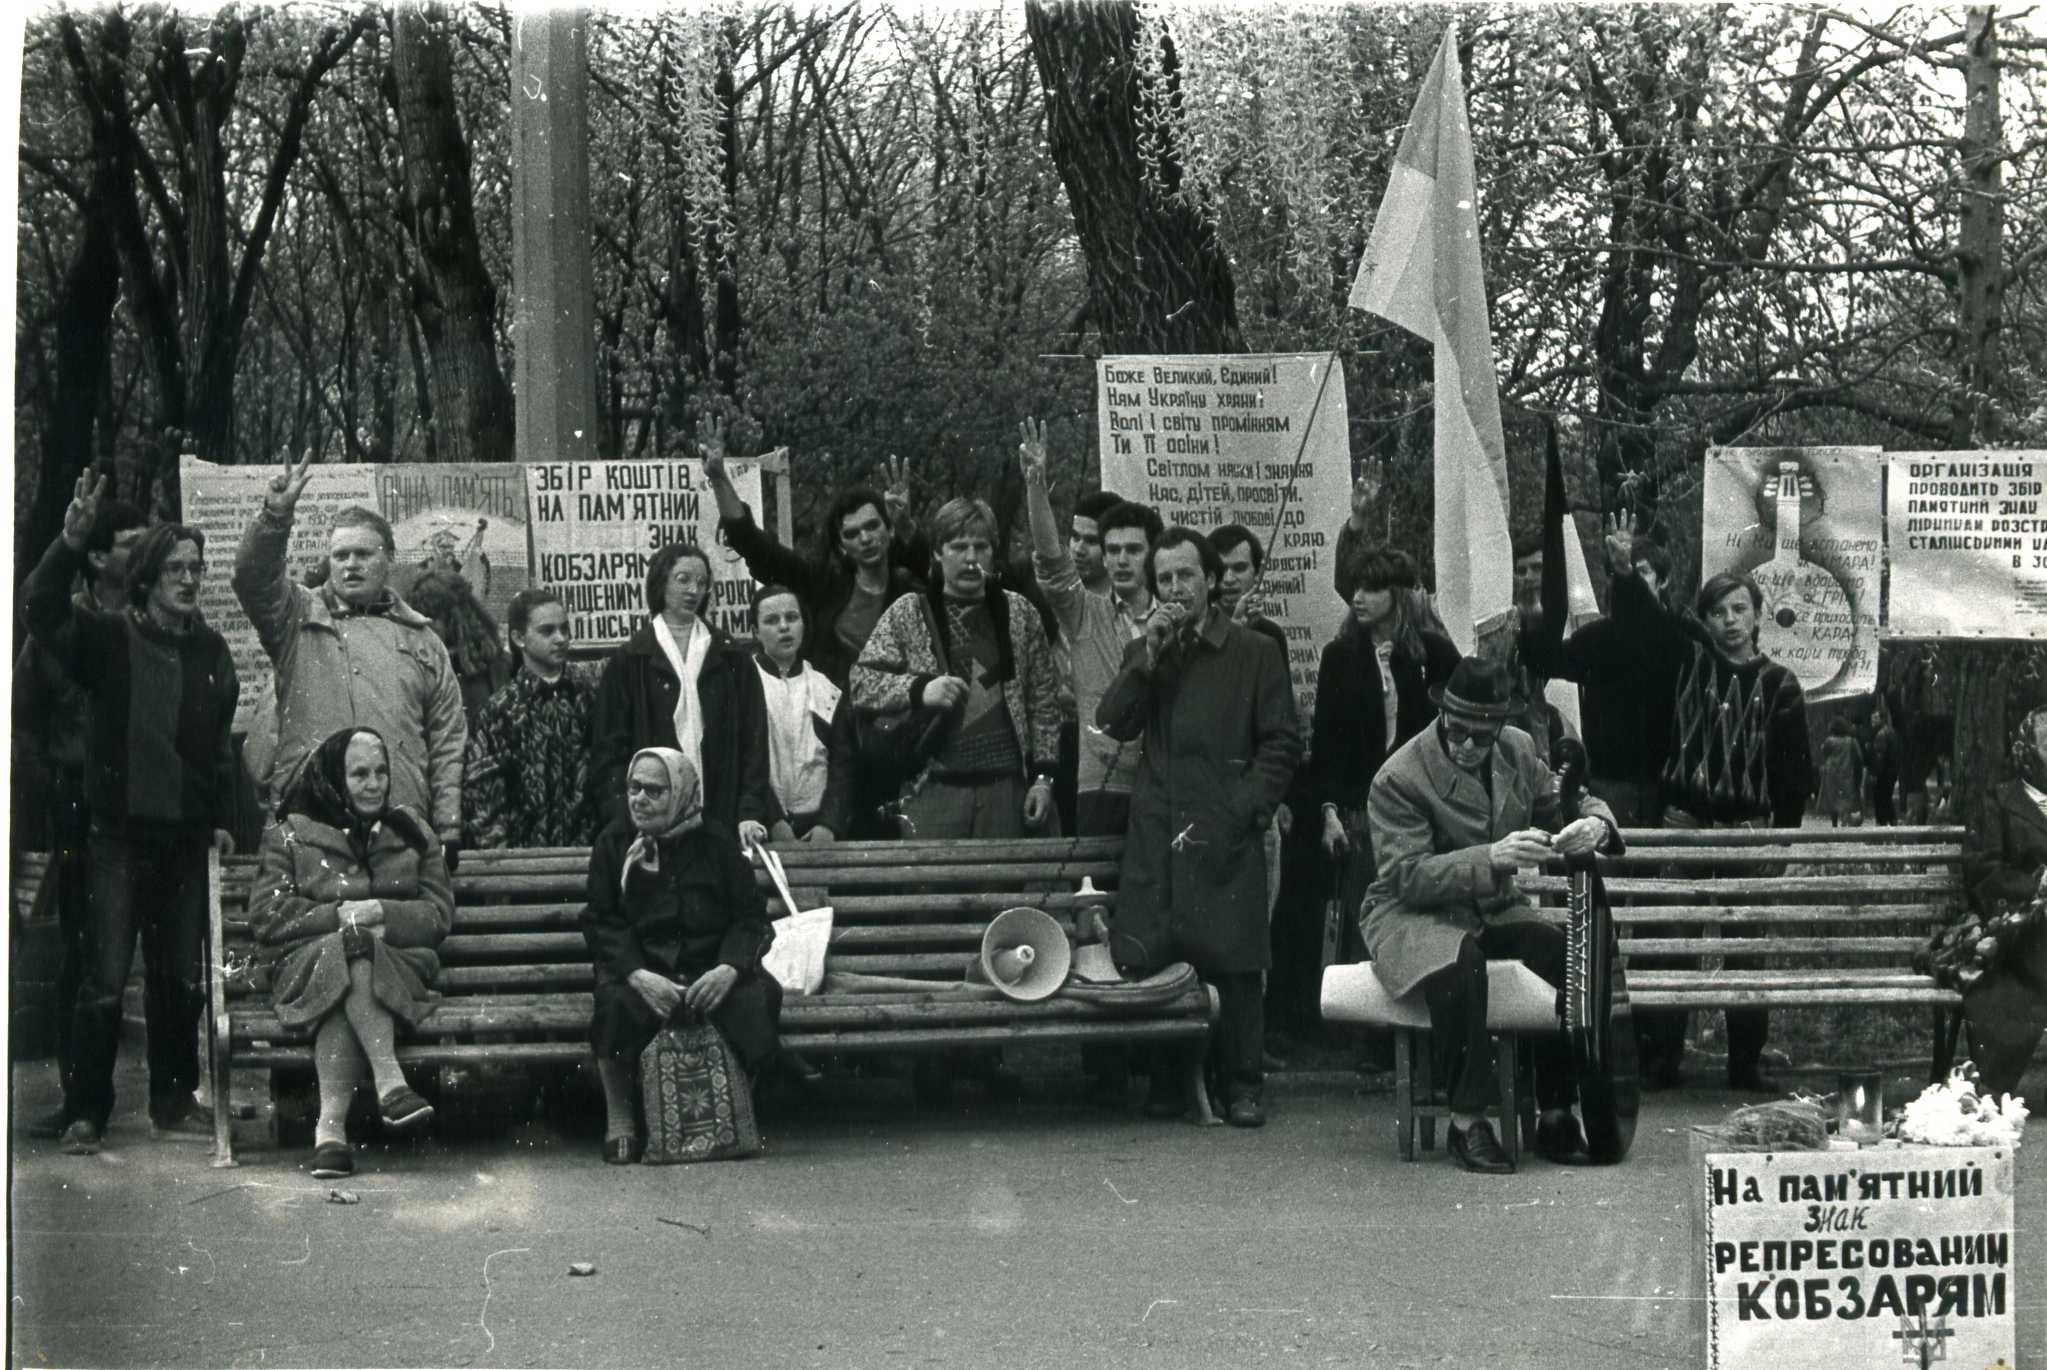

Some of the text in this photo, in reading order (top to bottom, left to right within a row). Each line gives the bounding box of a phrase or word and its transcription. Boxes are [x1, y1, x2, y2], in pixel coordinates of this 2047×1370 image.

[535, 462, 591, 491] ЗБІР
[605, 463, 690, 490] КОШТІВ
[1909, 463, 2033, 478] ОРГАНІЗАЦІЯ
[1908, 481, 2042, 497] ПРОВОДИТЬ ЗБІР
[537, 492, 700, 522] НА ПАМ'ЯТНИЙ
[649, 524, 698, 549] ЗНАК
[1908, 535, 2023, 550] СТАЛІНСЬКИМИ
[2012, 555, 2021, 568] В
[1712, 1168, 1764, 1206] На
[1736, 1272, 2007, 1322] КОБЗАРЯМ
